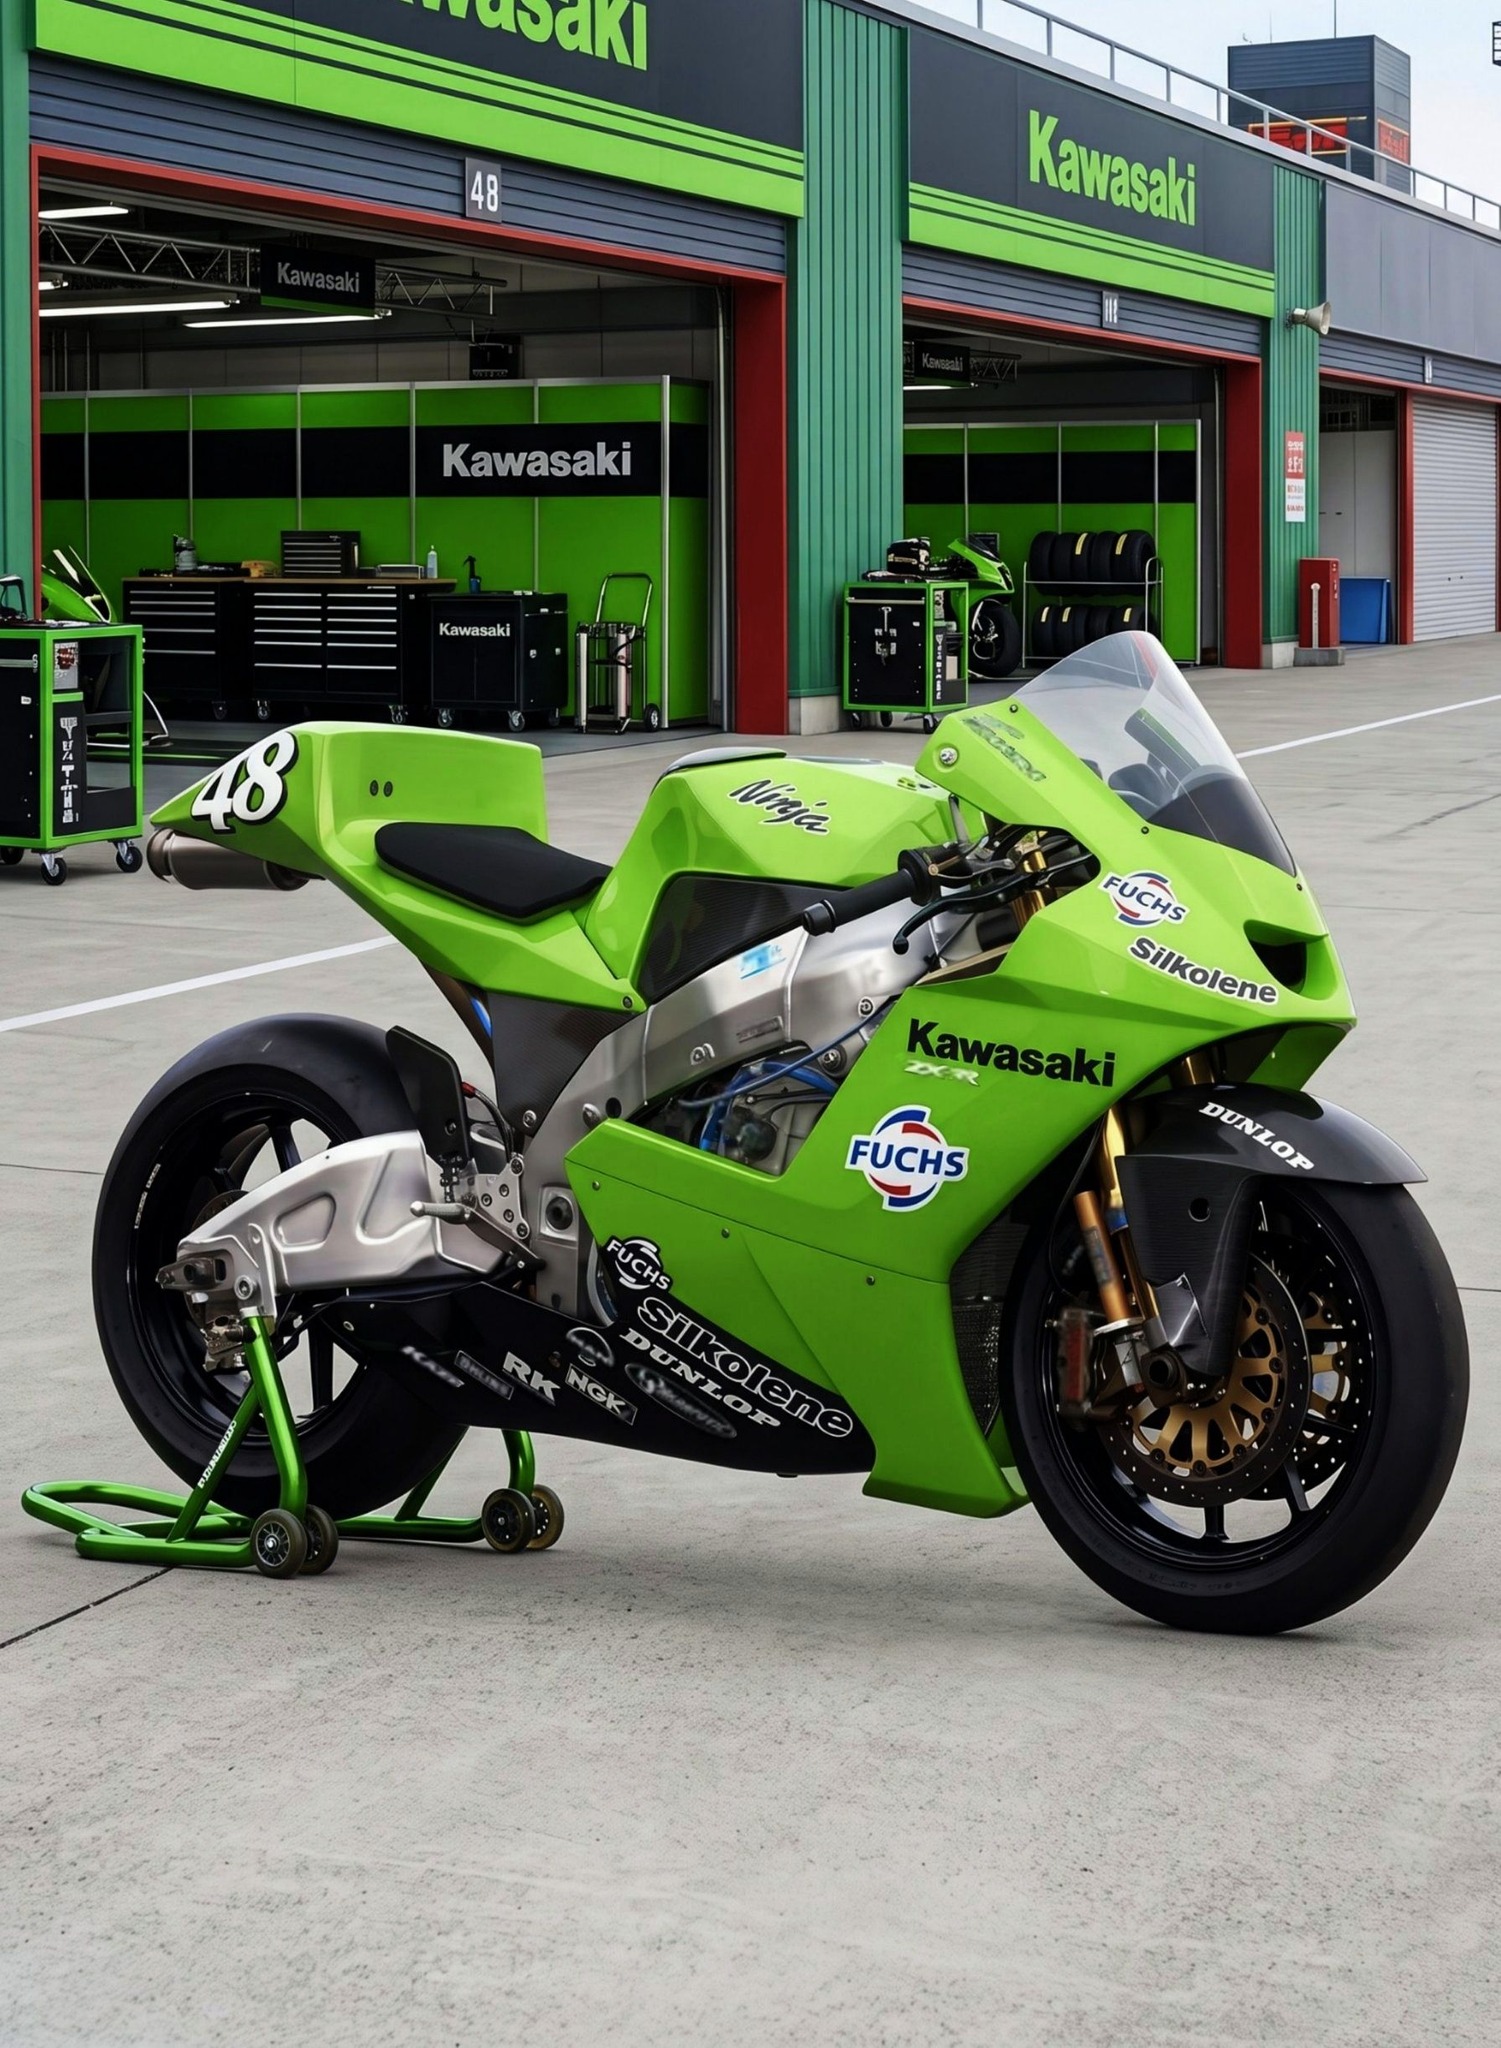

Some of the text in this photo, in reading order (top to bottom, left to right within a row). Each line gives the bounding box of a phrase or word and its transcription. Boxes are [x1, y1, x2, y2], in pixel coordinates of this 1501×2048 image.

[471, 171, 499, 213] 48
[1029, 109, 1196, 226] Kawasaki
[277, 262, 360, 294] Kawasaki
[443, 441, 631, 477] Kawasaki
[439, 622, 511, 637] Kawasaki
[190, 729, 299, 834] 48
[729, 779, 830, 833] Ninja
[1102, 875, 1187, 922] FUCHS
[1129, 936, 1278, 1003] Silkolene
[906, 1018, 1116, 1088] Kawasaki
[849, 1139, 966, 1177] FUCHS
[1199, 1101, 1315, 1170] DUNLOP
[606, 1238, 671, 1291] FUCHS
[503, 1350, 562, 1402] RK
[567, 1368, 627, 1416] NGK
[619, 1327, 782, 1428] DUNLOP
[637, 1296, 854, 1438] Silkolene
